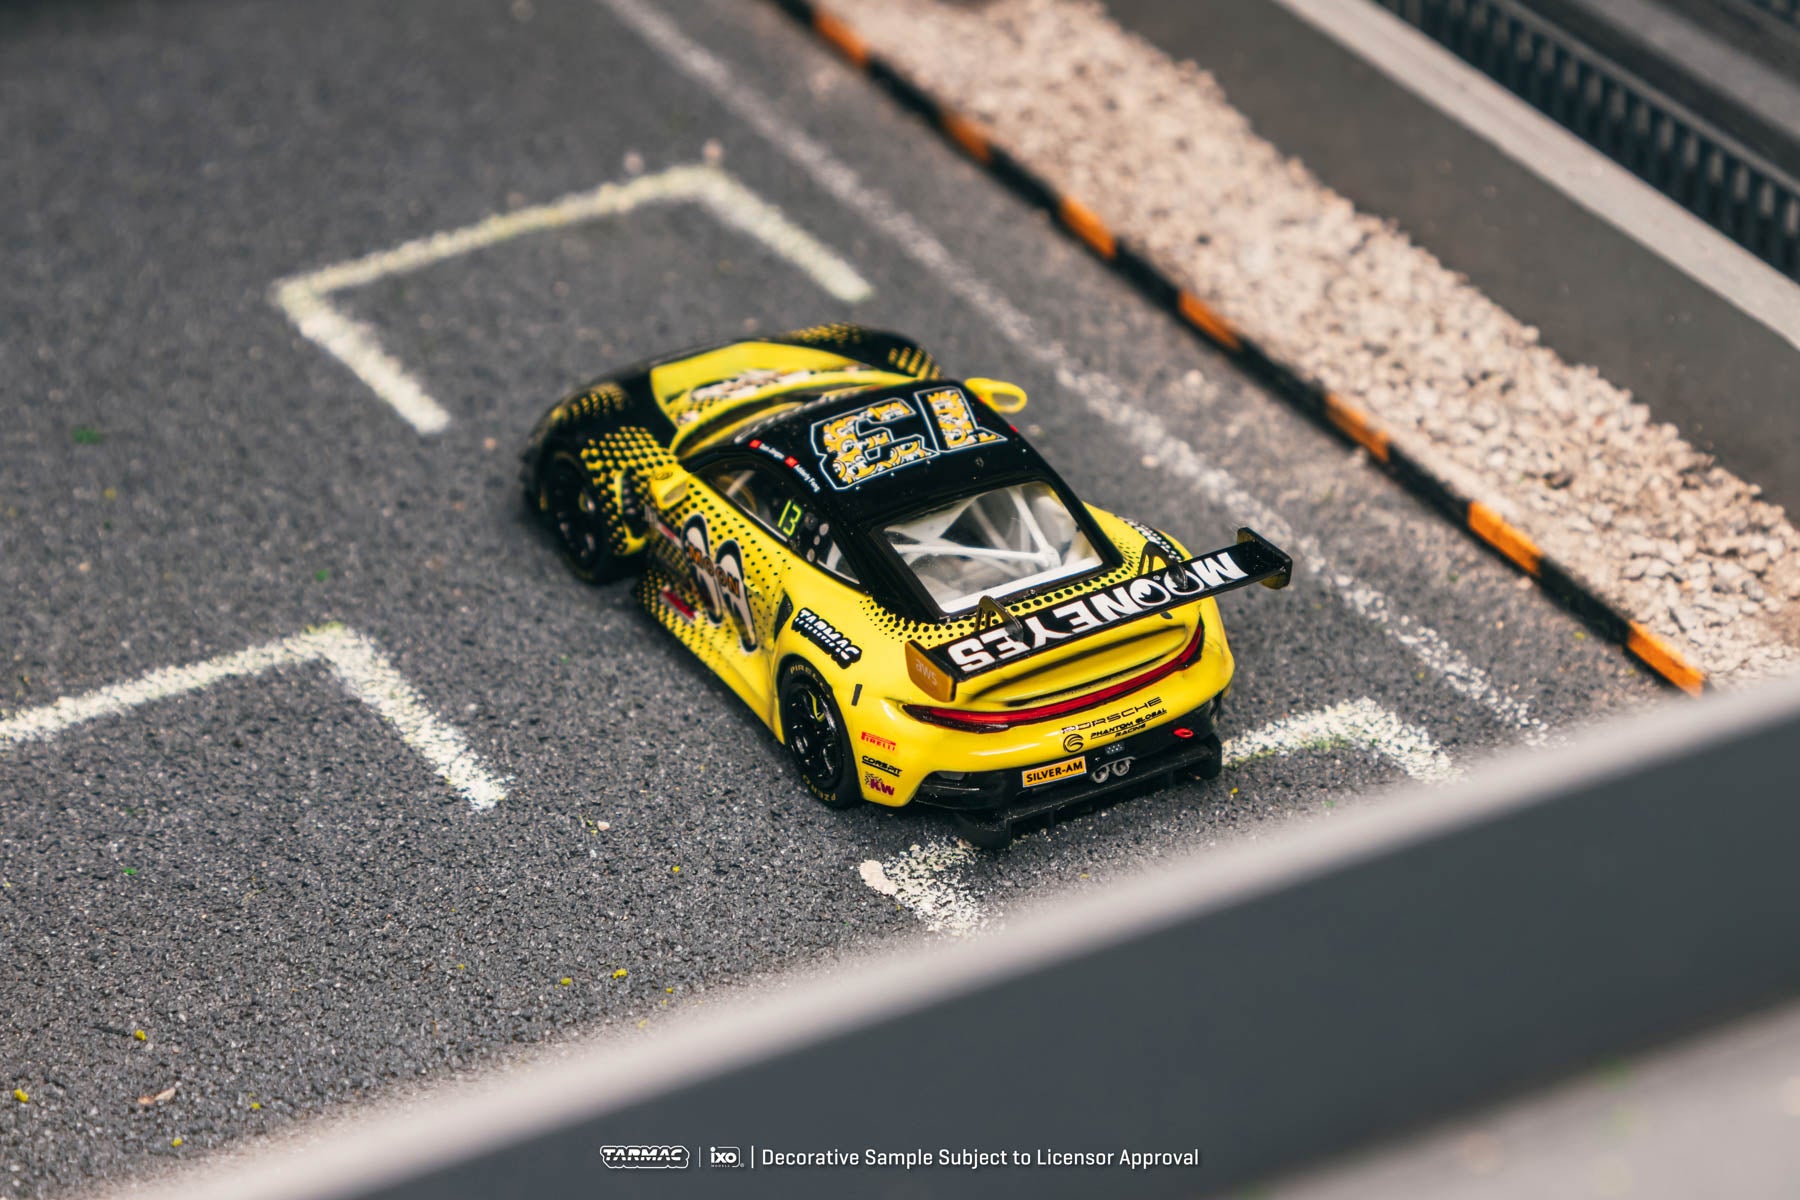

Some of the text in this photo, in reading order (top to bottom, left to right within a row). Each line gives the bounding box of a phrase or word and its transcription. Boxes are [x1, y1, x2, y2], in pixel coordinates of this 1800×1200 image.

[778, 500, 802, 537] 13
[687, 543, 741, 600] MOON
[947, 551, 1249, 673] MOONEYES
[793, 607, 862, 664] TARMAC
[1061, 697, 1162, 733] PORSCHE
[1091, 708, 1167, 738] PHANTOM GLOBAL
[1115, 723, 1146, 737] RACING
[861, 731, 896, 751] PIRELLI
[870, 778, 895, 796] KW
[1026, 761, 1084, 782] SILVER-AM
